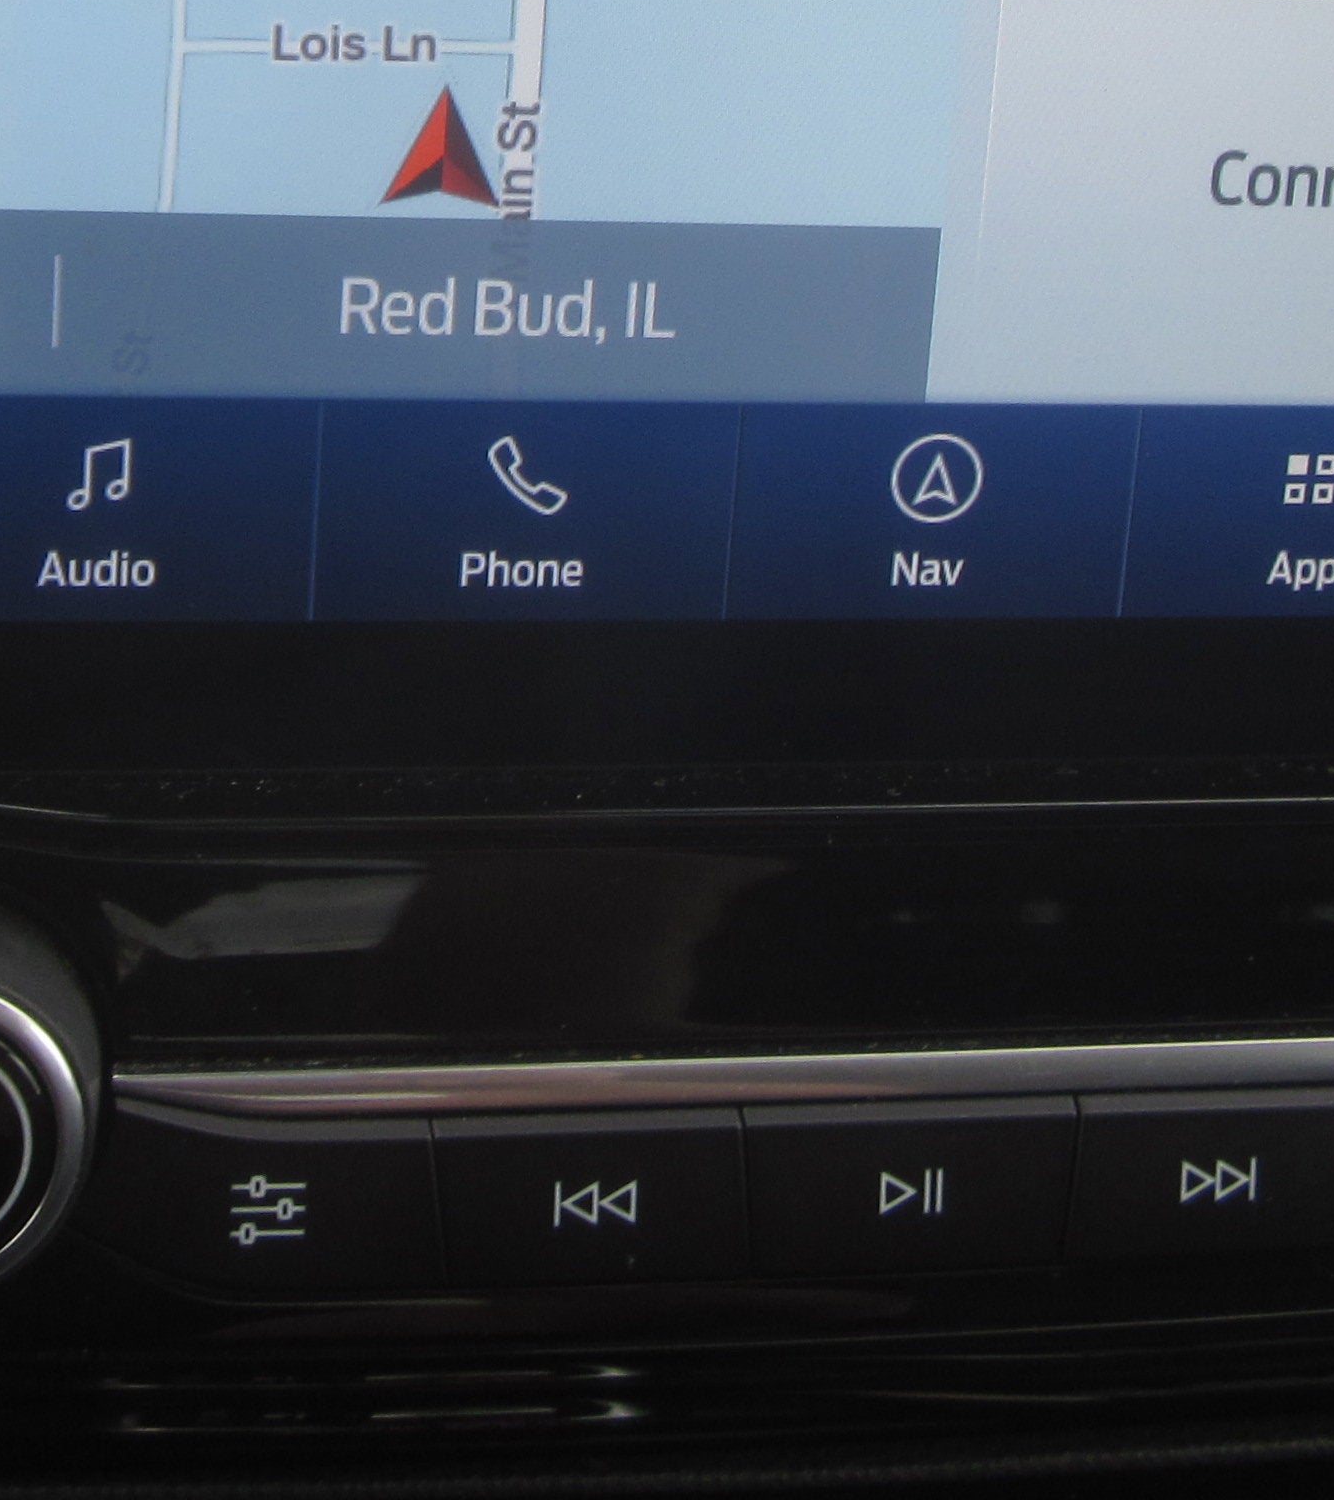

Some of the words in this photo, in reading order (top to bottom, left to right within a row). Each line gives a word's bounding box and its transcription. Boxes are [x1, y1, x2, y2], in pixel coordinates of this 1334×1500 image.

[273, 23, 366, 62] Lois
[383, 24, 438, 63] Ln
[496, 101, 541, 152] St
[339, 275, 457, 337] Red
[473, 277, 607, 346] Bud,
[624, 280, 677, 340] IL
[36, 548, 157, 588] Audio
[459, 549, 585, 589] Phone
[890, 550, 965, 588] Nav
